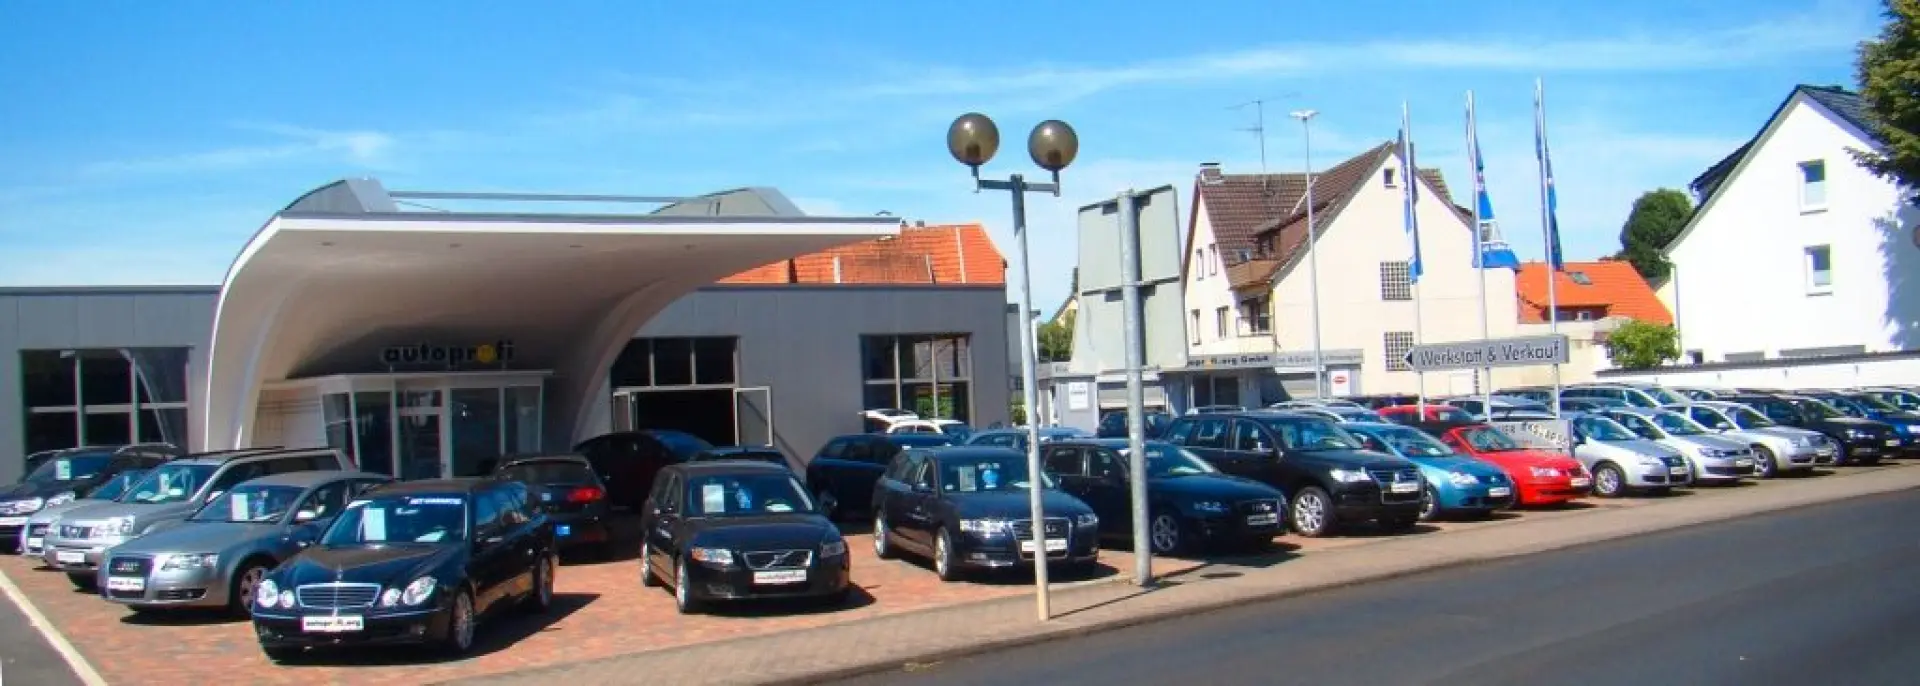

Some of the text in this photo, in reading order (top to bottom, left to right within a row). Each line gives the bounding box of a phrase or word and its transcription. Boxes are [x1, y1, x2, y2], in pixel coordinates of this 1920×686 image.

[383, 340, 515, 369] autoprofi
[1420, 340, 1560, 366] Werkstatt & Verkauf
